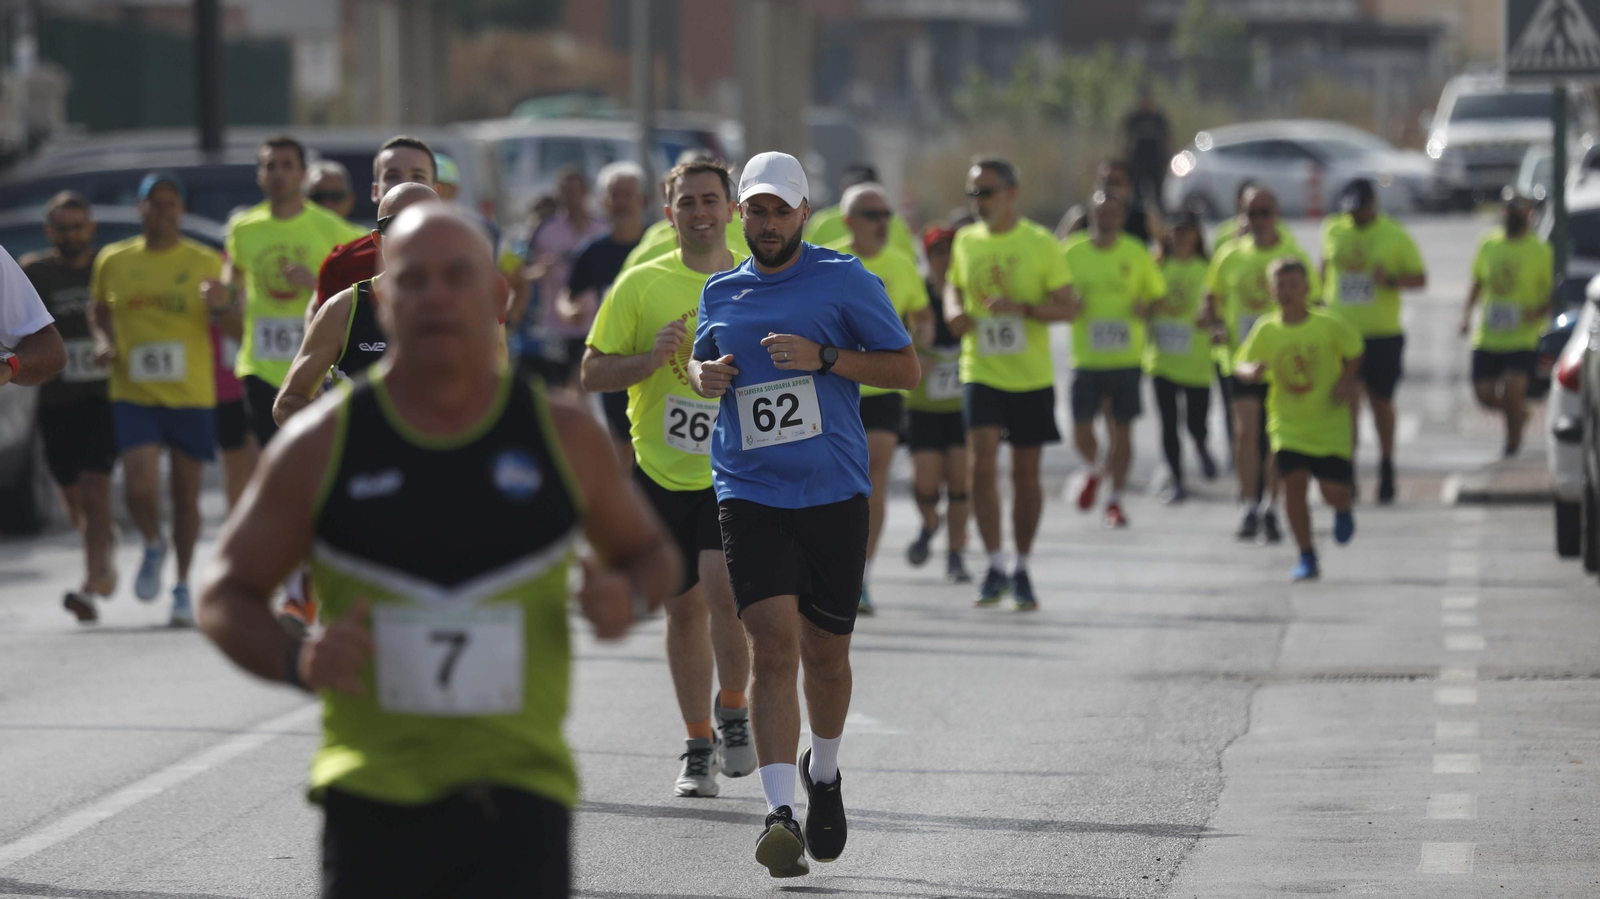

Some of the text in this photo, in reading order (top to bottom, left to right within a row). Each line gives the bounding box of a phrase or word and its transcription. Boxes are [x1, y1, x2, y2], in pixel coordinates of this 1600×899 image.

[986, 324, 1016, 348] 16
[142, 351, 174, 375] 61
[744, 387, 764, 396] CARRERA
[764, 381, 791, 392] SOLIDARIA
[669, 408, 718, 442] 26
[752, 393, 803, 432] 62
[428, 631, 470, 690] 7
